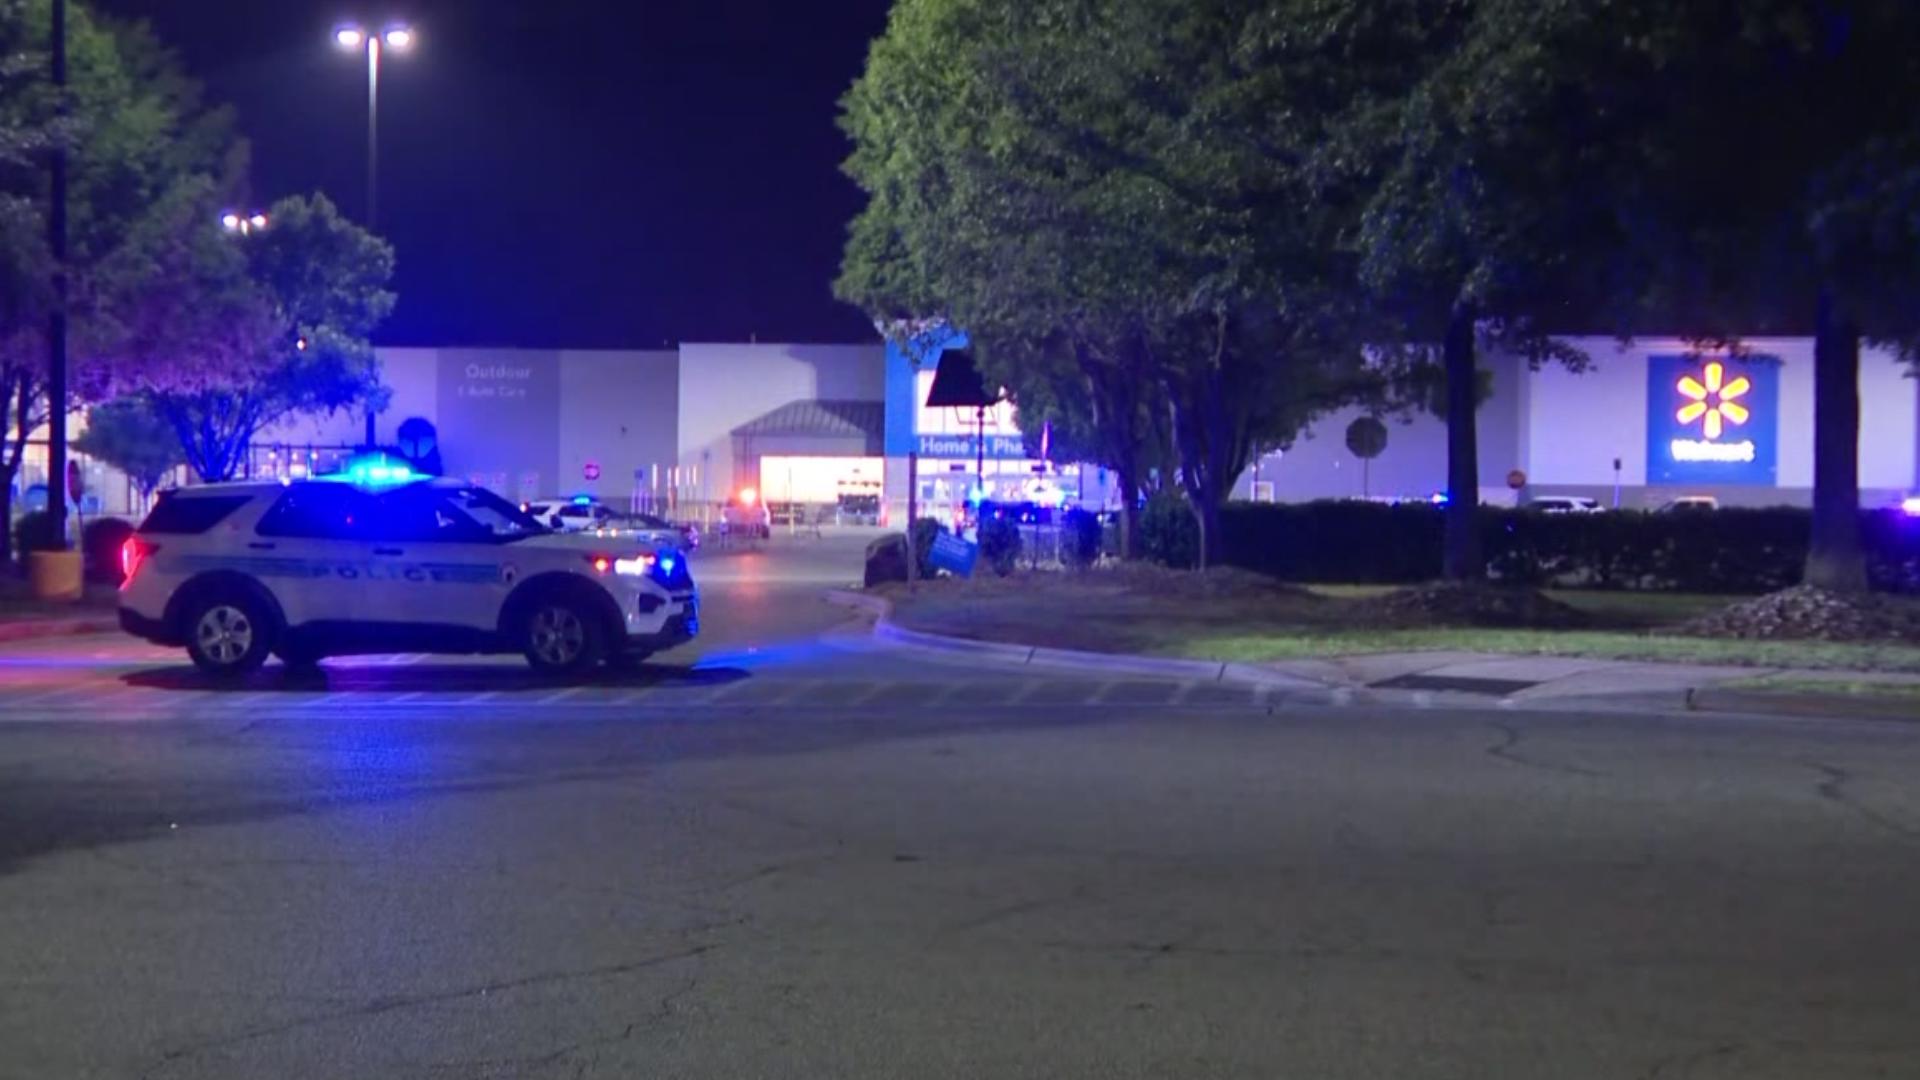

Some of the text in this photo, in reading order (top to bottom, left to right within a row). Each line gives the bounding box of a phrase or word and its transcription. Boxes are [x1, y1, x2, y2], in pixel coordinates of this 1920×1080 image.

[465, 363, 532, 379] Outdoor
[920, 436, 969, 454] Home
[993, 437, 1026, 454] Pha
[1671, 438, 1755, 462] Walmart
[310, 564, 445, 582] POLICE
